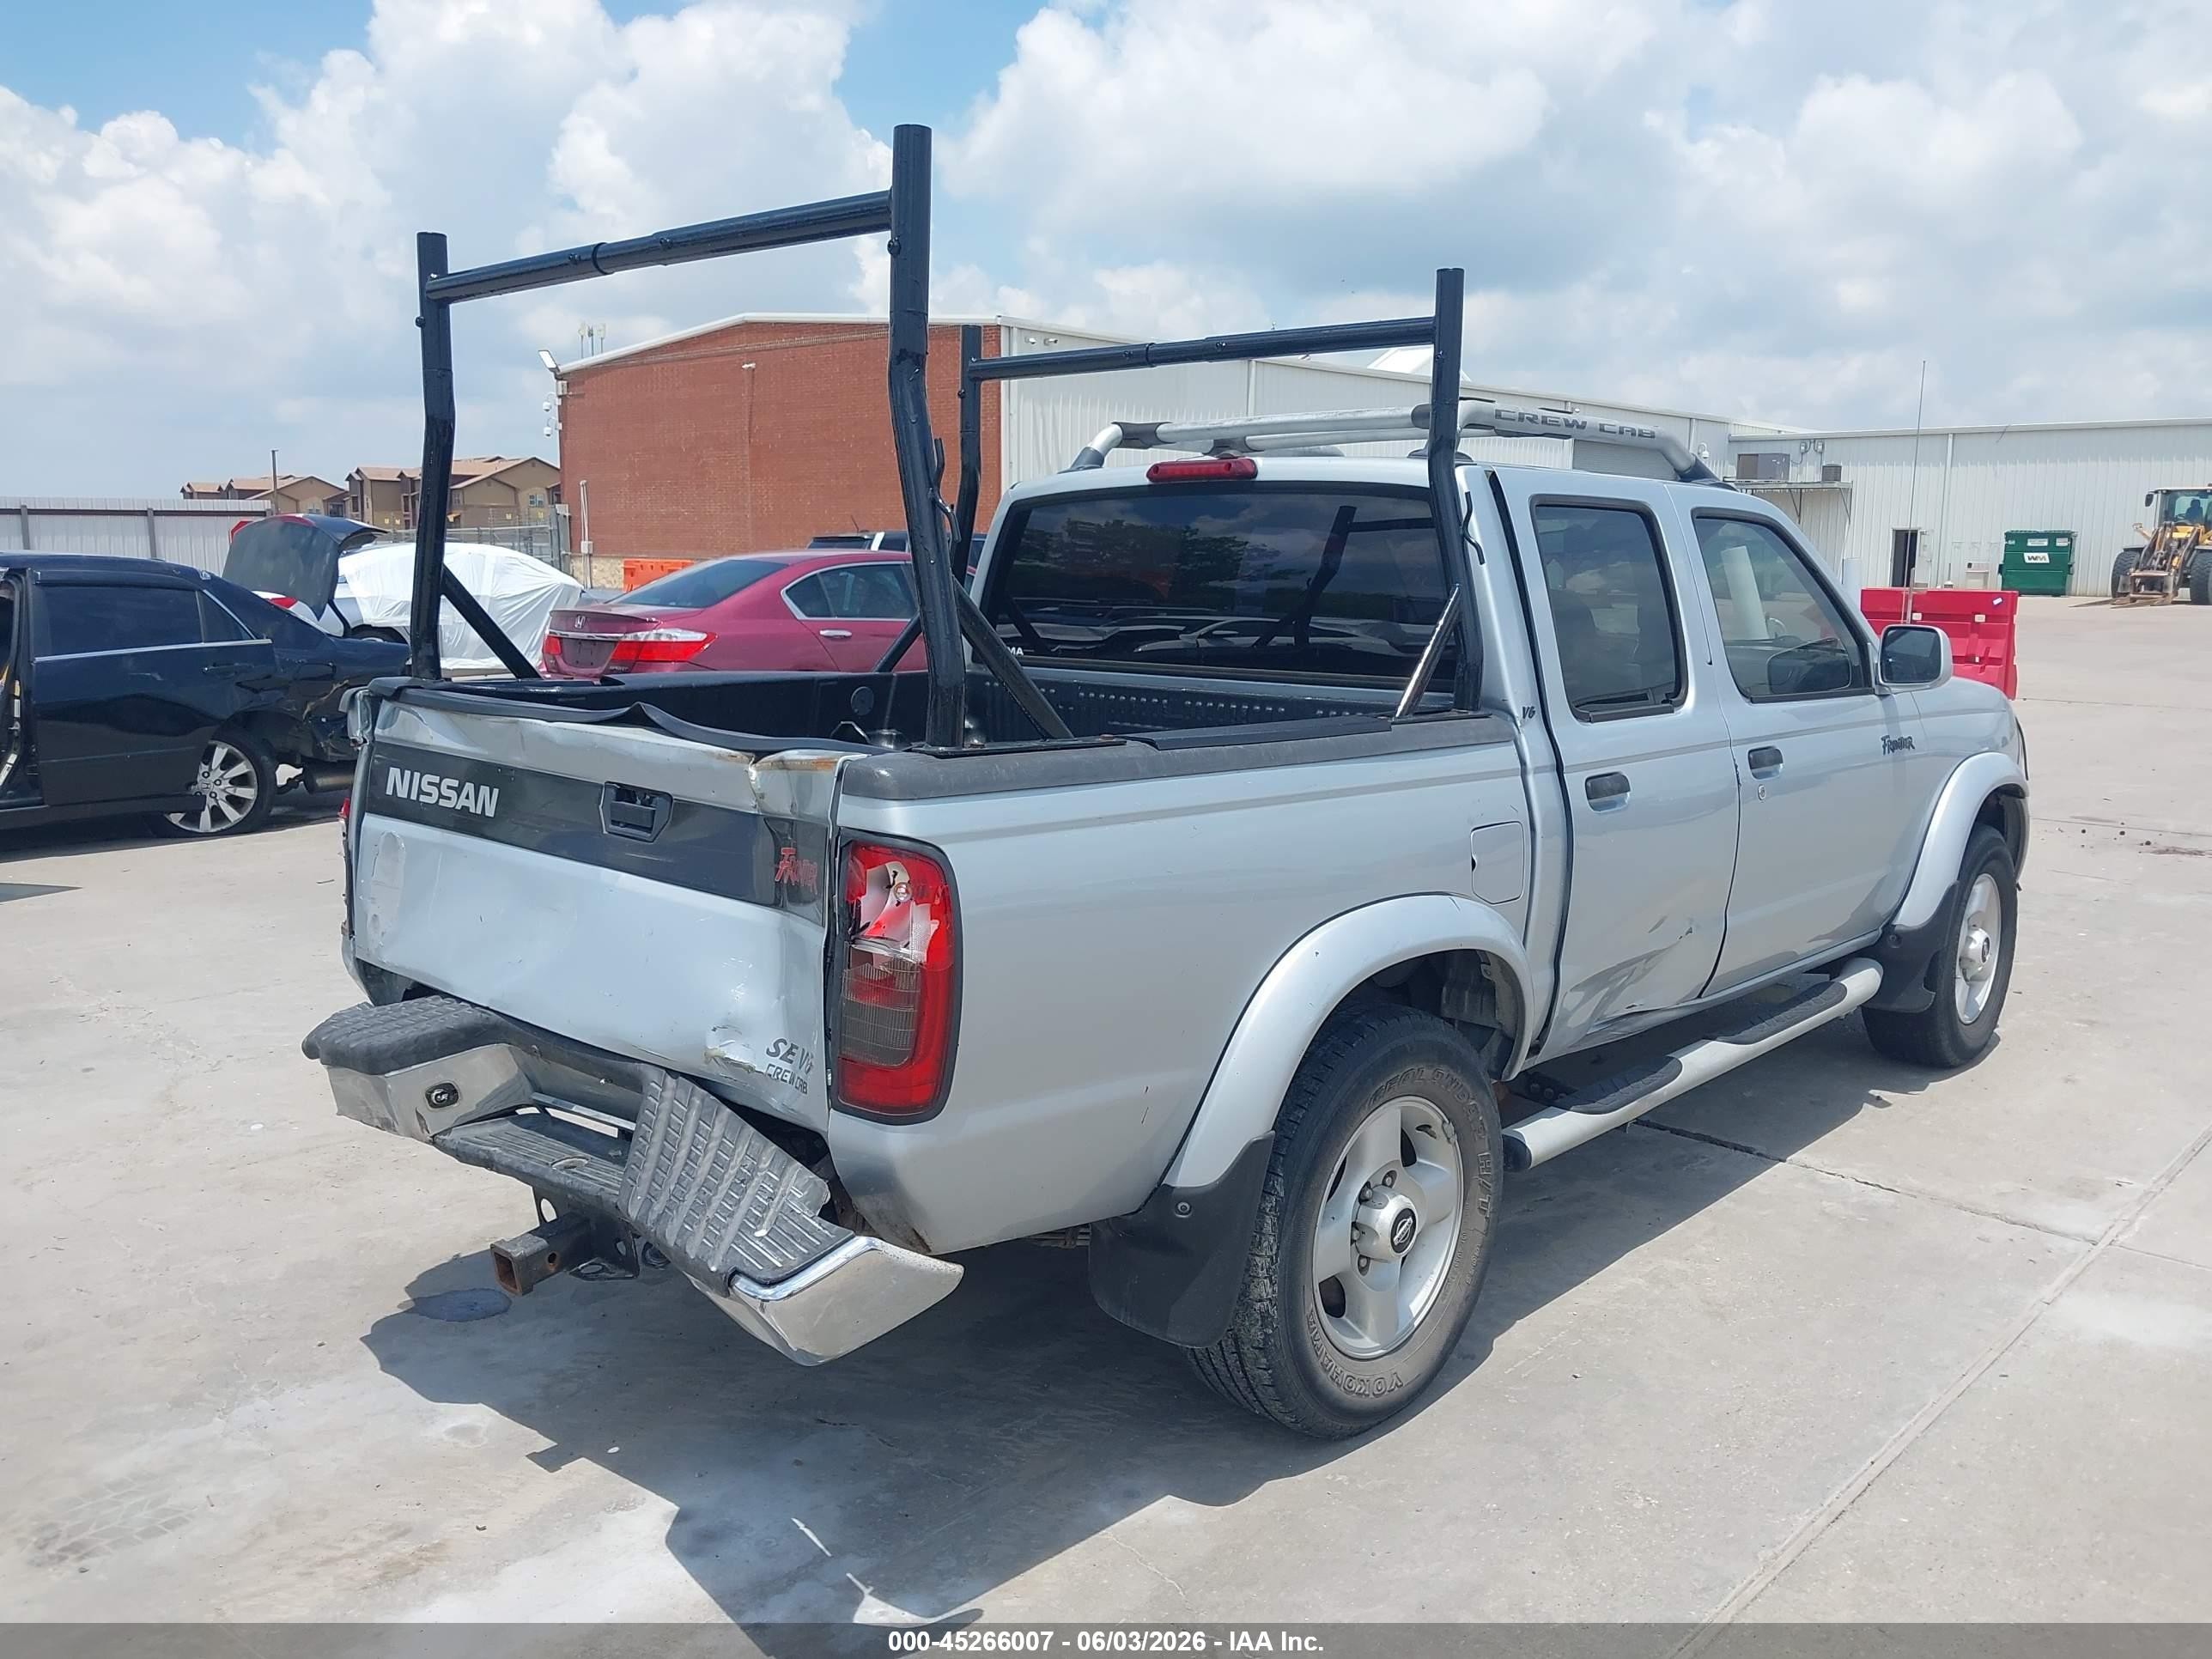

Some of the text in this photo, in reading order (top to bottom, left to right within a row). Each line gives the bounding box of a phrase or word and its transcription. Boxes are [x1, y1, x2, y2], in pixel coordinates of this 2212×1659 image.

[1494, 409, 1656, 439] CREW CAB
[386, 767, 500, 817] NISSAN
[765, 1037, 799, 1065] SE
[1306, 1306, 1404, 1398] YOKOHAMA
